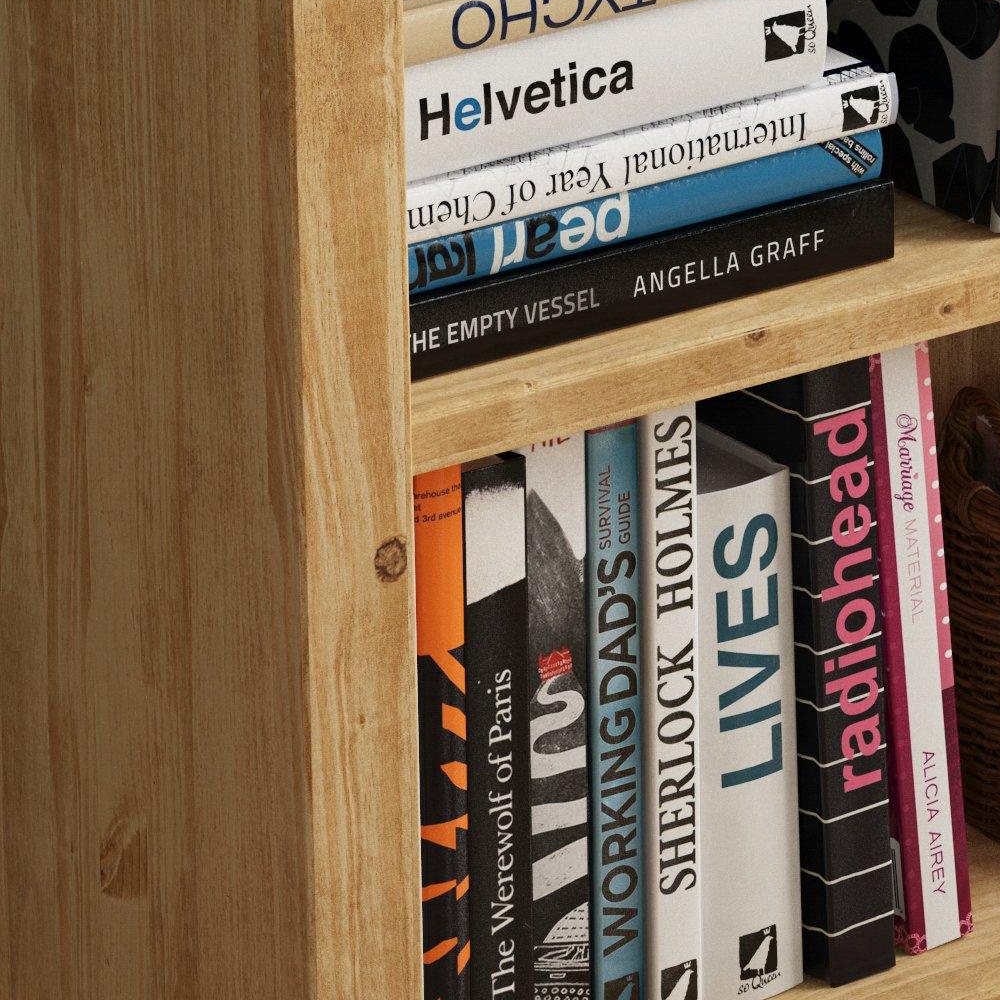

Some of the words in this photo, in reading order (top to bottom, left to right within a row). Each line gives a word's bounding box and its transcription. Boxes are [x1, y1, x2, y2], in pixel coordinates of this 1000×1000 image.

[418, 58, 635, 141] Helvetica
[545, 159, 612, 198] Year
[624, 112, 807, 176] International
[825, 141, 852, 164] special
[851, 160, 865, 175] with
[854, 144, 876, 163] rollins
[501, 179, 536, 215] of
[489, 192, 630, 275] pearl
[633, 250, 740, 299] ANGELLA
[750, 228, 826, 269] GRAFF
[409, 326, 440, 354] HE
[447, 306, 519, 345] EMPTY
[524, 287, 601, 325] VESSEL
[896, 413, 919, 513] Marriage
[598, 464, 611, 550] SURVIVAL
[618, 491, 631, 544] GUIDE
[654, 415, 694, 619] HOLMES
[813, 407, 882, 793] radiohead
[904, 518, 924, 625] MATERIAL
[713, 513, 783, 788] LIVES
[487, 668, 513, 749] Paris
[488, 751, 513, 784] of
[657, 639, 697, 895] SHERLOCK
[922, 751, 940, 823] ALICIA
[488, 791, 514, 936] Werewolf
[928, 831, 946, 895] AIREY
[490, 938, 516, 1000] The
[738, 984, 749, 996] so
